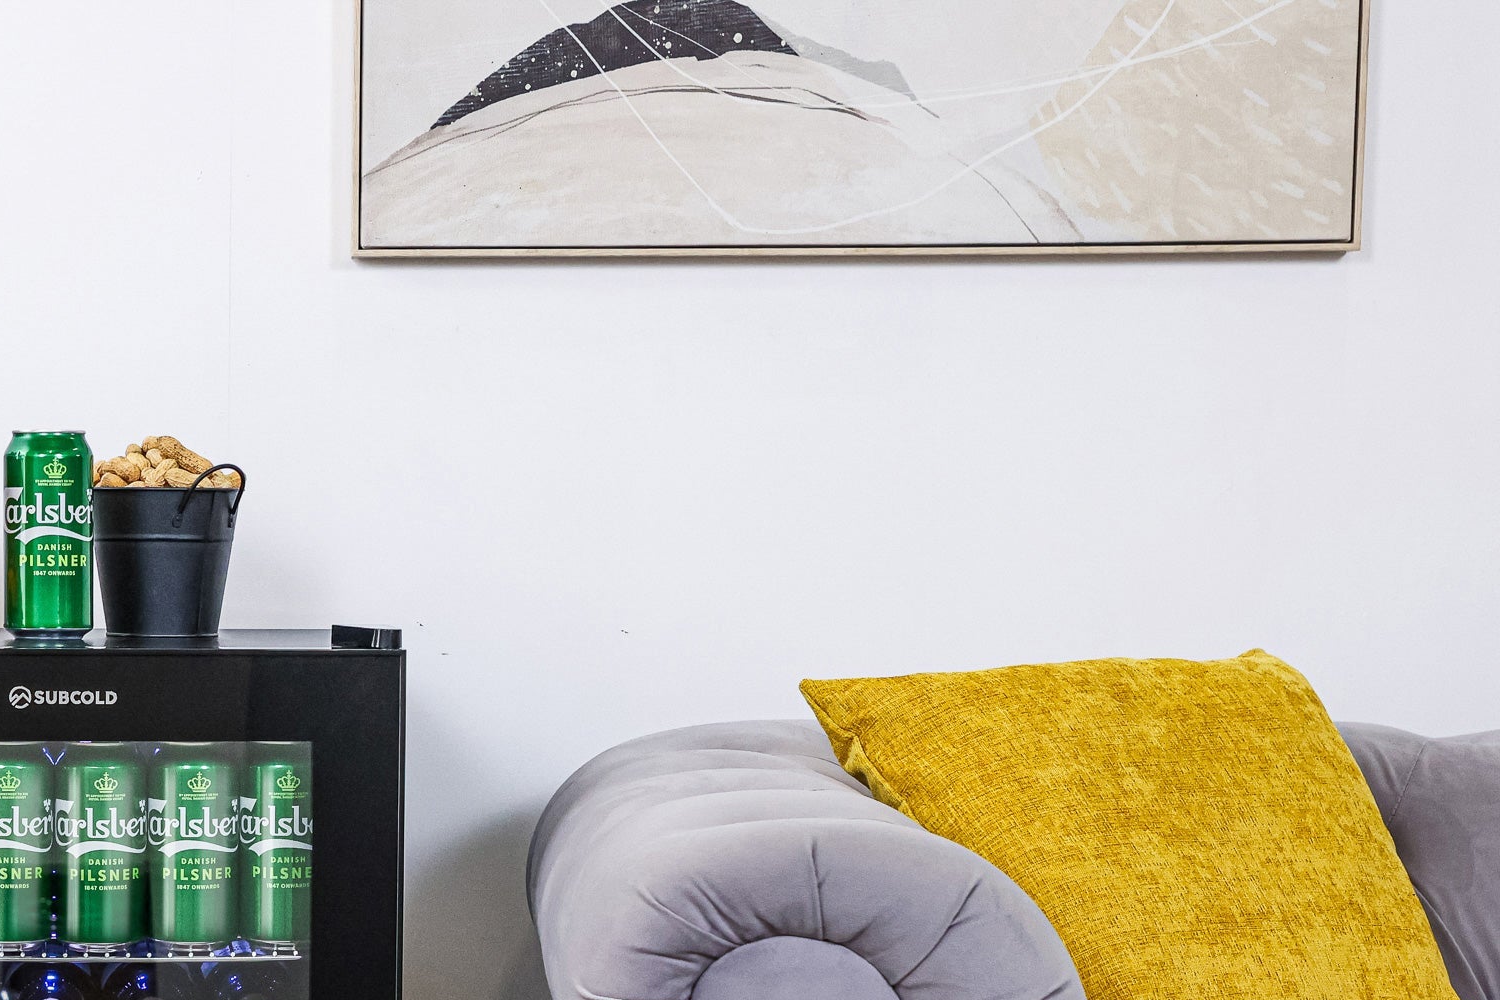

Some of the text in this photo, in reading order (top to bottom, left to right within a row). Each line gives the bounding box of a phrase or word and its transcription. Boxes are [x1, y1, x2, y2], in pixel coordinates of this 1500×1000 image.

[4, 487, 93, 533] Carlsber
[19, 554, 87, 567] PILSNER
[33, 690, 118, 706] SUBCOLD
[55, 798, 147, 846] Carlsber
[148, 797, 238, 846] Carlsber
[240, 796, 313, 844] Carlsb
[88, 858, 124, 866] DANISH
[181, 857, 216, 865] DANISH
[69, 867, 140, 882] PILSNER
[162, 866, 232, 881] PILSNER
[252, 865, 312, 880] PILSNE
